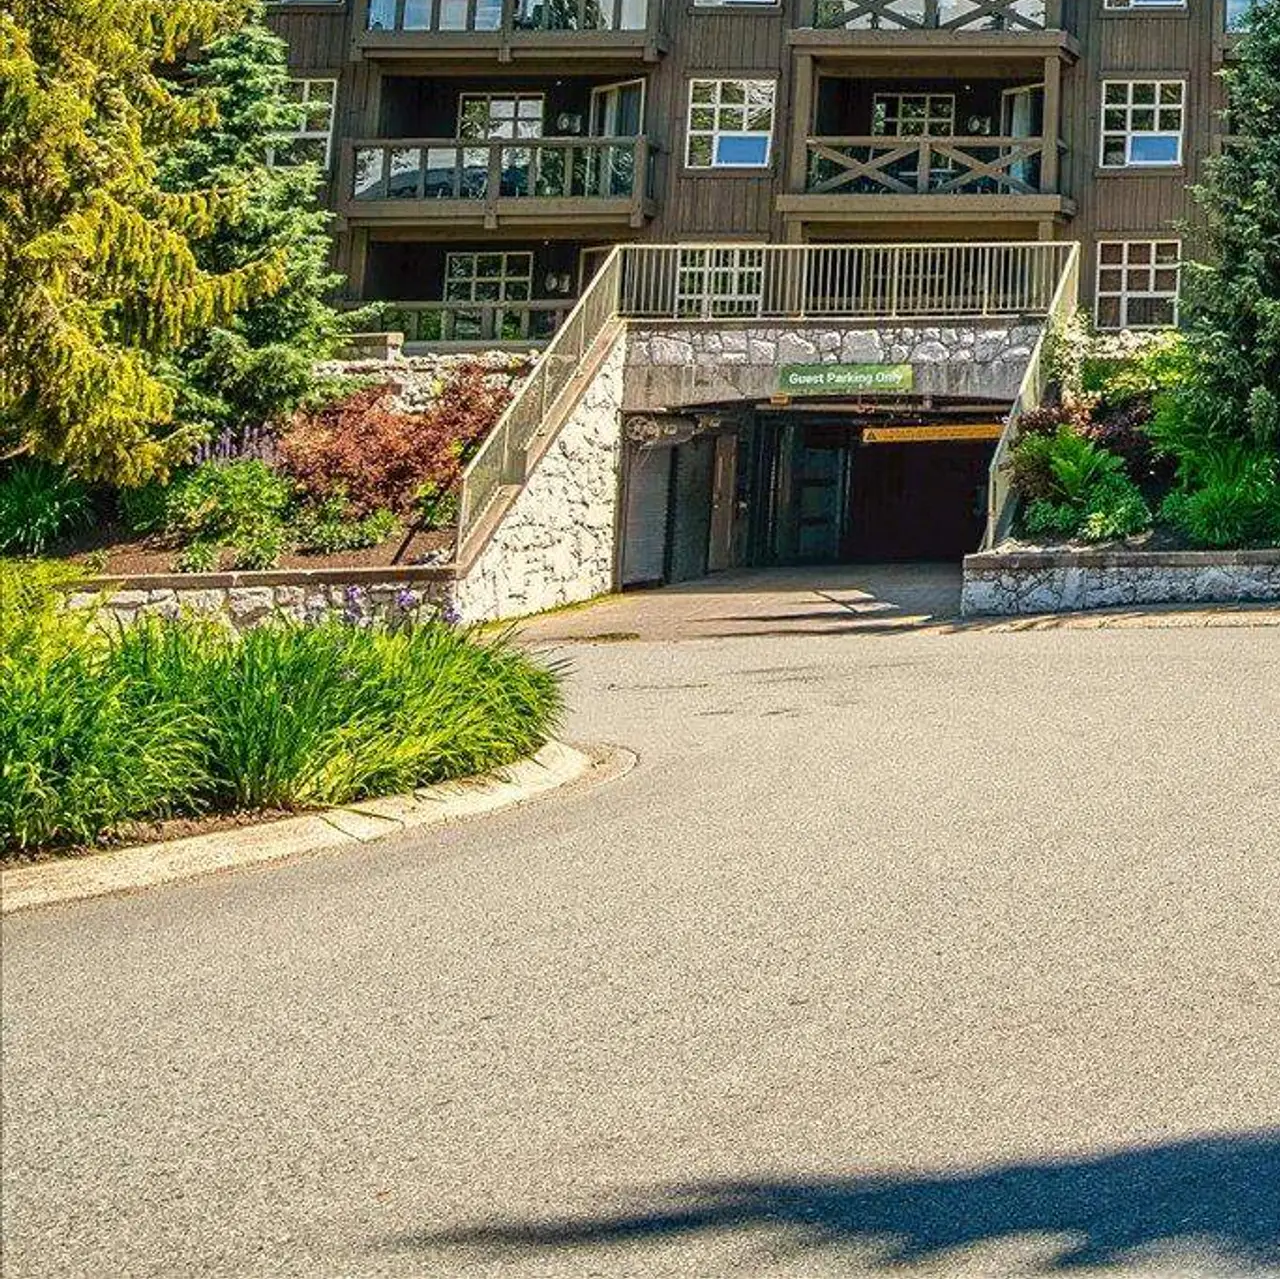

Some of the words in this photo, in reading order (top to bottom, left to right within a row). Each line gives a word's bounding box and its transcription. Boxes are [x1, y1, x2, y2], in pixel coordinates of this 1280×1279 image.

[789, 372, 824, 384] Guest
[826, 372, 873, 385] Parking
[875, 372, 903, 384] Only
